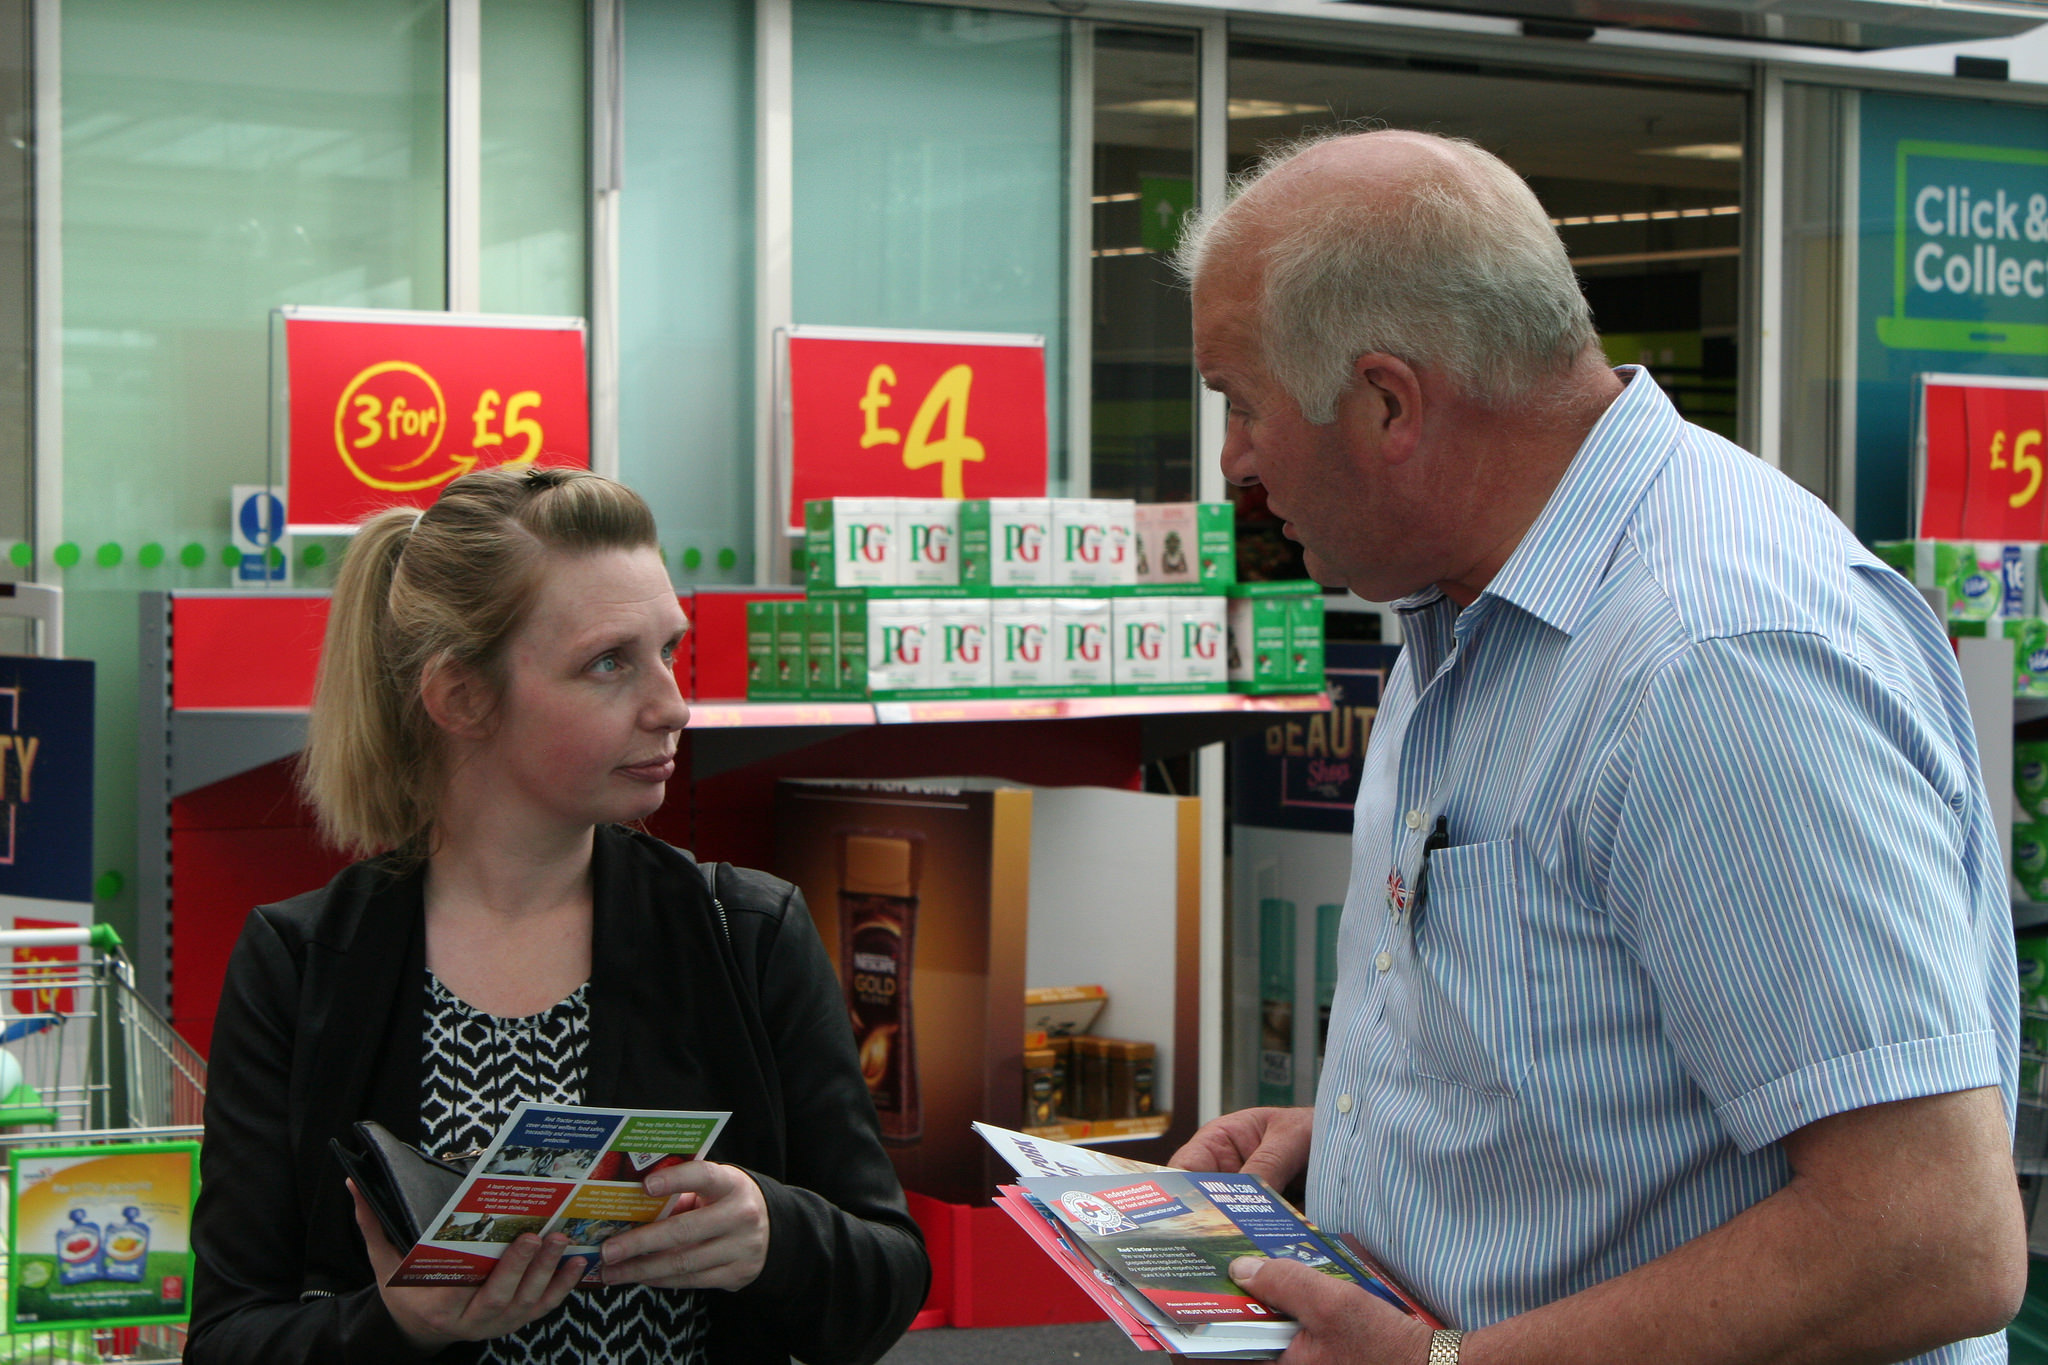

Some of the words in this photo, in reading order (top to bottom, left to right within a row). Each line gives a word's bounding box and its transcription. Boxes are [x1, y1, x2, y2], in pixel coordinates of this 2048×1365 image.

[1915, 185, 2019, 240] Click
[2024, 193, 2048, 242] &
[1914, 242, 2048, 299] Collec
[353, 394, 382, 448] 3
[386, 395, 438, 440] for
[472, 388, 544, 471] £5
[857, 363, 986, 498] £4
[1989, 430, 2042, 508] £5
[848, 523, 885, 563] PG
[910, 524, 948, 563] PG
[1004, 524, 1042, 562] PG
[1064, 524, 1102, 563] PG
[882, 625, 921, 664] PG
[943, 625, 981, 663] PG
[1005, 624, 1042, 663] PG
[1065, 622, 1101, 662] PG
[1125, 622, 1161, 660] PG
[1183, 621, 1217, 660] PG
[855, 973, 897, 996] GOLD
[1104, 1184, 1154, 1198] Independently
[1112, 1194, 1137, 1205] approved
[1136, 1191, 1160, 1200] standards
[1146, 1196, 1168, 1206] farming
[1198, 1181, 1230, 1193] WIN
[1209, 1194, 1272, 1204] MINI-BREAK
[1226, 1204, 1276, 1213] EVERYDAY
